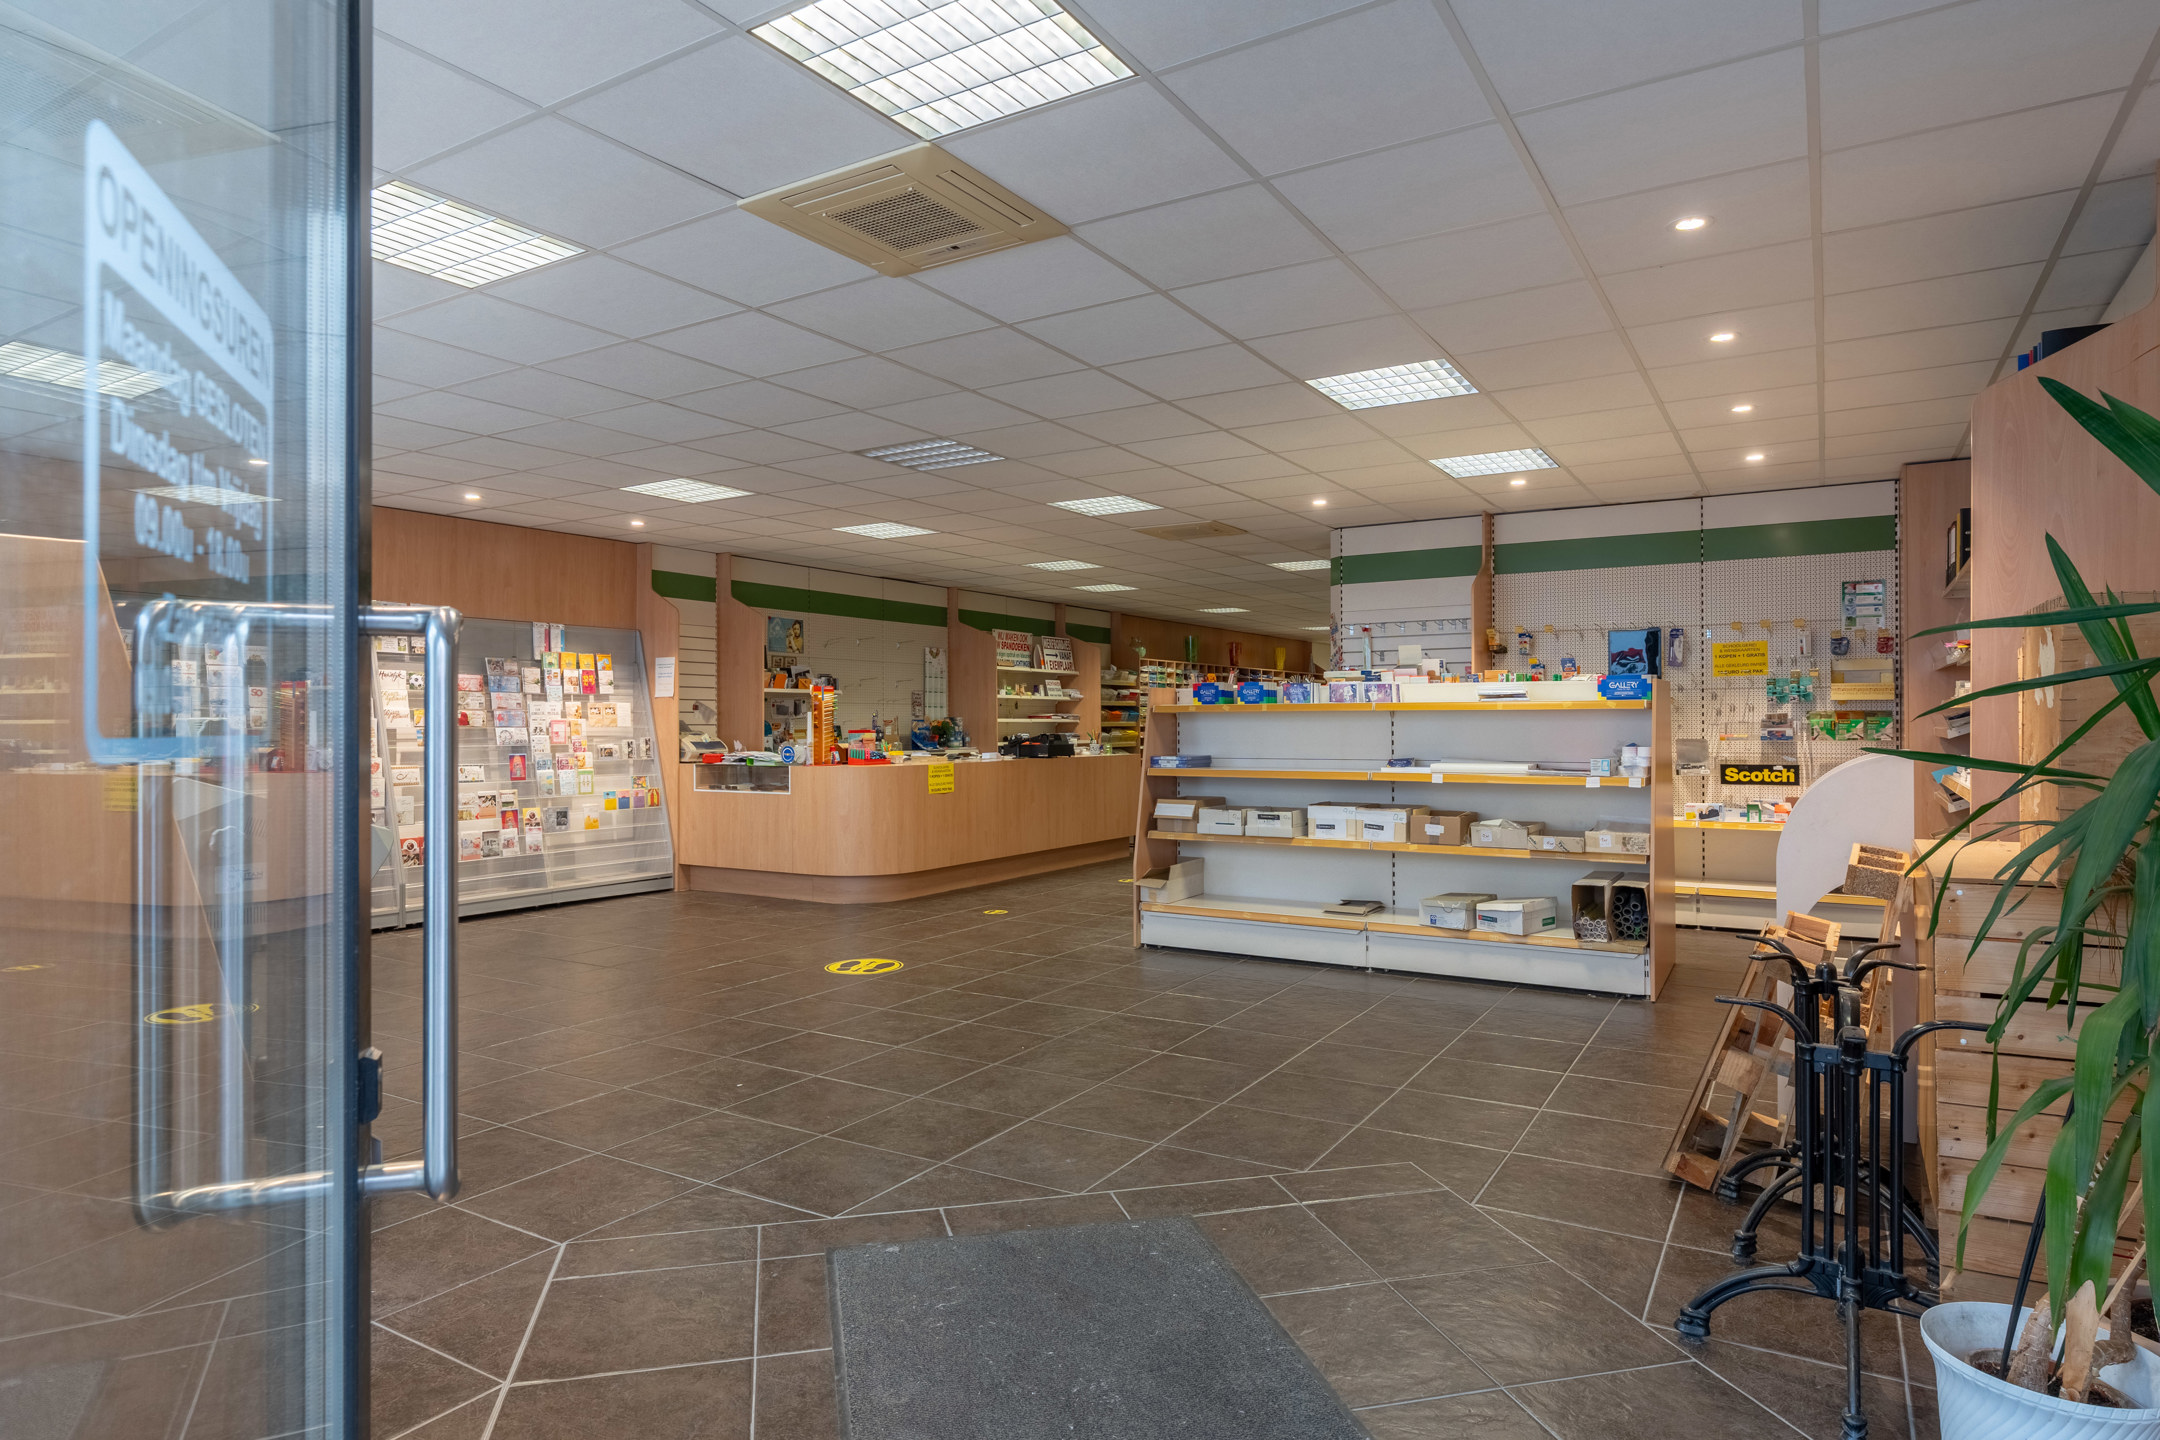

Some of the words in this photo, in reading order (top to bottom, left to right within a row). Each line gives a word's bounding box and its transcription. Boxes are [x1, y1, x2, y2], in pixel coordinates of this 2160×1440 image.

[98, 164, 271, 393] OPENINGSUREN
[103, 288, 192, 419] Maandag
[194, 371, 268, 468] GESLOTEN
[110, 397, 191, 503] Dinsdag
[1001, 641, 1030, 652] SPANDOEKEN
[1608, 681, 1640, 689] GALLERY
[1725, 767, 1795, 783] Scotch
